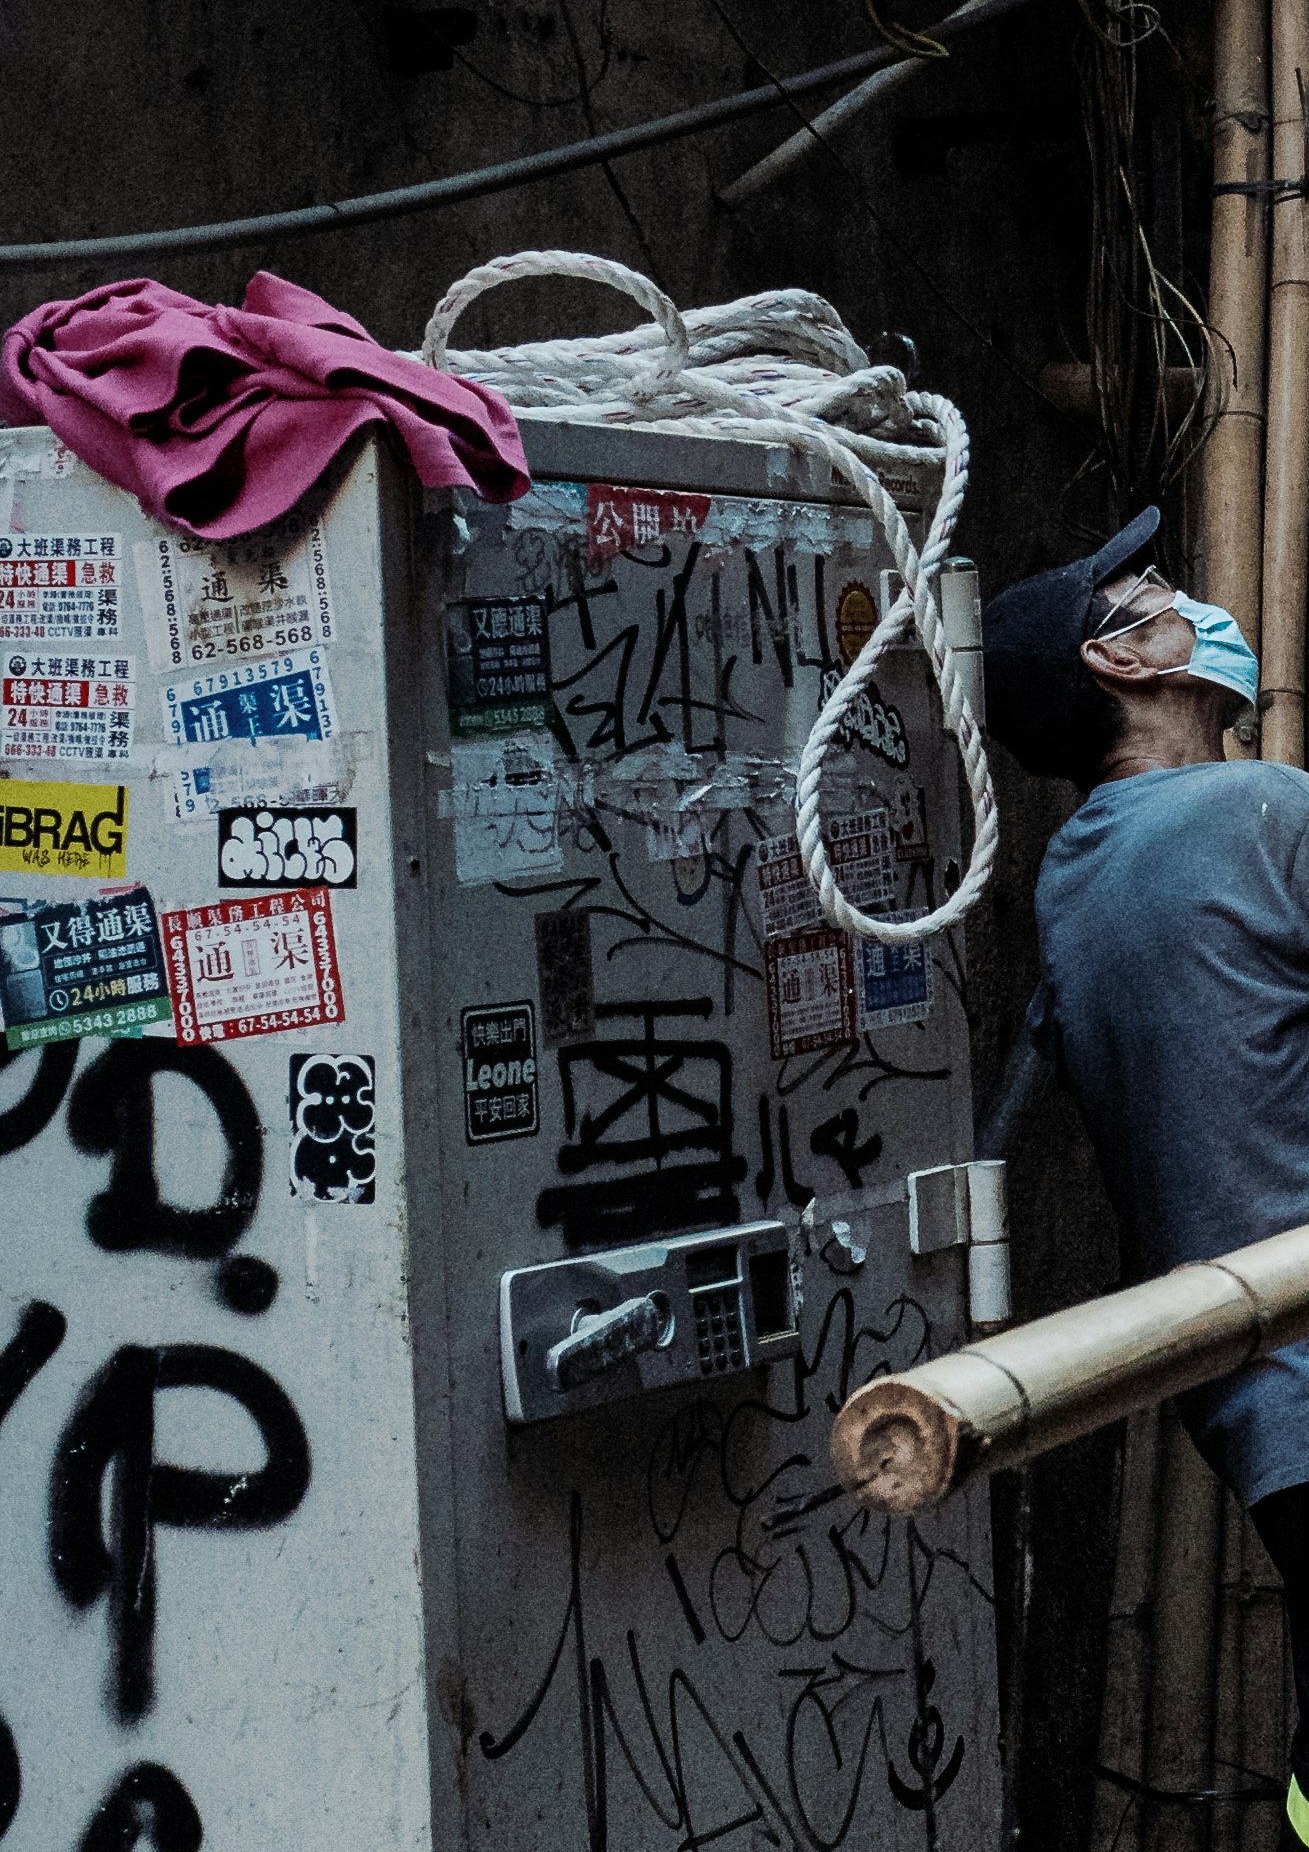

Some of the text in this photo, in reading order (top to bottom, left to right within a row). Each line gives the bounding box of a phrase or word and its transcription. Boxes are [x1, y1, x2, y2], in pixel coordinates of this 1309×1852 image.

[17, 537, 115, 558] 大班渠務工程
[81, 561, 115, 585] 急救
[191, 625, 313, 661] 62-568-568
[31, 656, 130, 679] 大班渠務工程
[193, 657, 294, 697] 67913579
[10, 680, 129, 707] 特快通渠 急救
[7, 707, 28, 728] 24
[41, 902, 153, 954] 又得通渠
[193, 927, 309, 983] 通渠
[312, 911, 338, 1019] 64337000
[70, 972, 160, 1007] 24小時服務
[170, 935, 196, 1042] 64337000
[72, 1003, 158, 1034] 5343 2888
[238, 1006, 322, 1034] 67-54-54-54
[471, 1018, 527, 1047] 快樂出門
[466, 1058, 537, 1092] Leone
[474, 1093, 530, 1123] 平安回家
